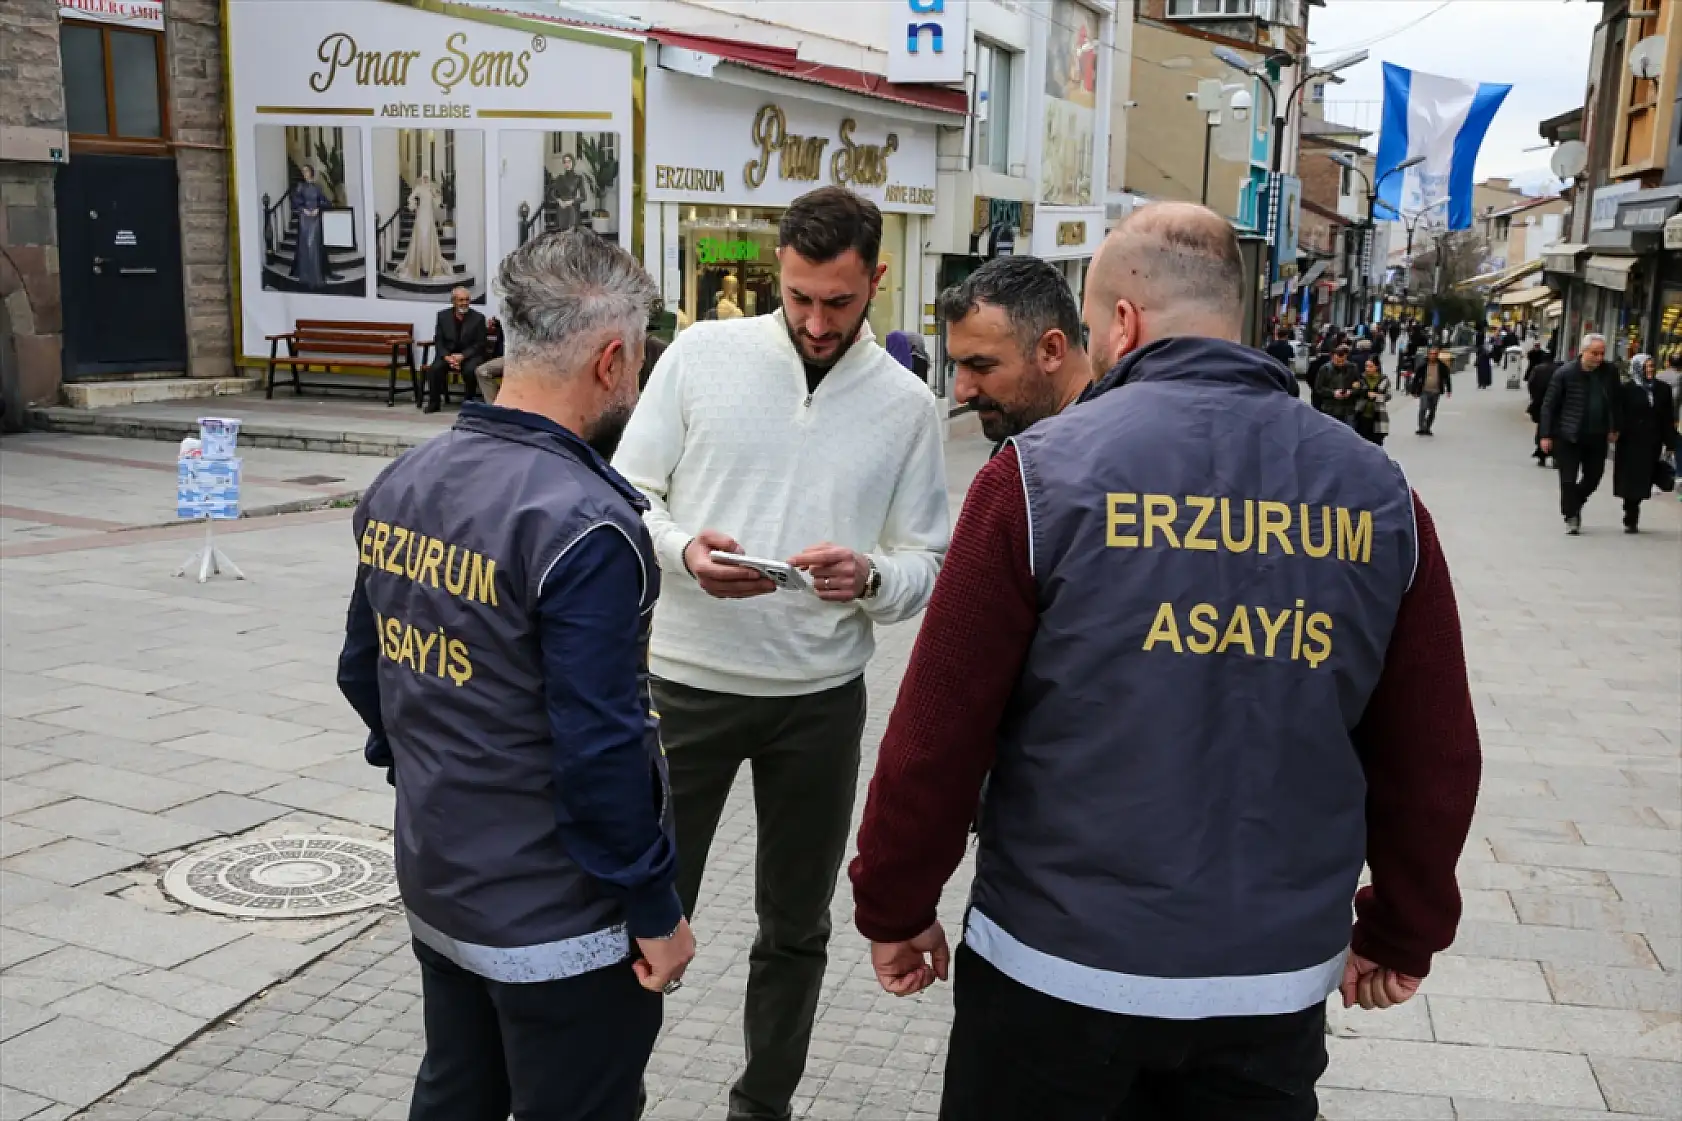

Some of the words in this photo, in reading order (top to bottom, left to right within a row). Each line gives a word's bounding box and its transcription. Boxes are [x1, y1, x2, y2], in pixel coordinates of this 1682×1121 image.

[309, 32, 421, 93] Pınar
[380, 101, 419, 117] ABİYE
[423, 102, 471, 118] ELBİSE
[655, 164, 725, 192] ERZURUM
[1105, 493, 1373, 563] ERZURUM
[360, 519, 498, 607] ERZURUM
[1141, 599, 1333, 668] ASAYİŞ
